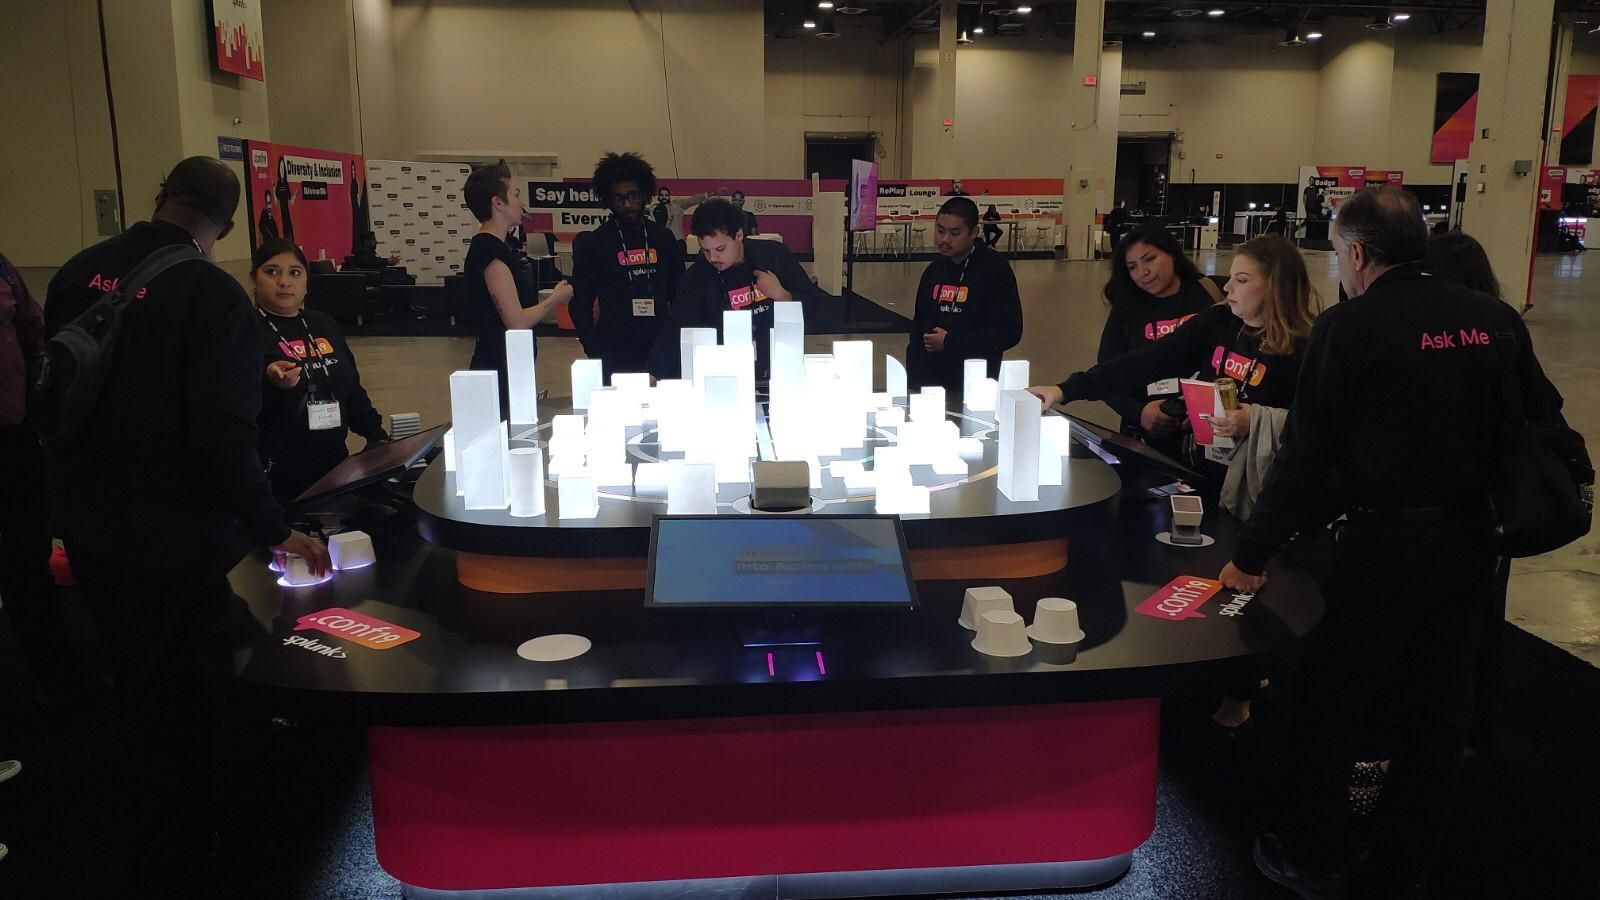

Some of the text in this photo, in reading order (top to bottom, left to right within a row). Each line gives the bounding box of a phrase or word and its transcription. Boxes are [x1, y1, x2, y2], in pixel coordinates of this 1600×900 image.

[286, 160, 342, 179] Diversity & Inclusion
[535, 187, 600, 204] Say hel
[880, 187, 905, 195] RePlay
[561, 212, 609, 225] Every
[1421, 327, 1490, 350] Ask Me
[736, 561, 769, 571] Into
[774, 561, 826, 571] Action
[1156, 580, 1212, 616] .conf19
[1219, 591, 1256, 617] splunk
[309, 615, 401, 644] .conf19
